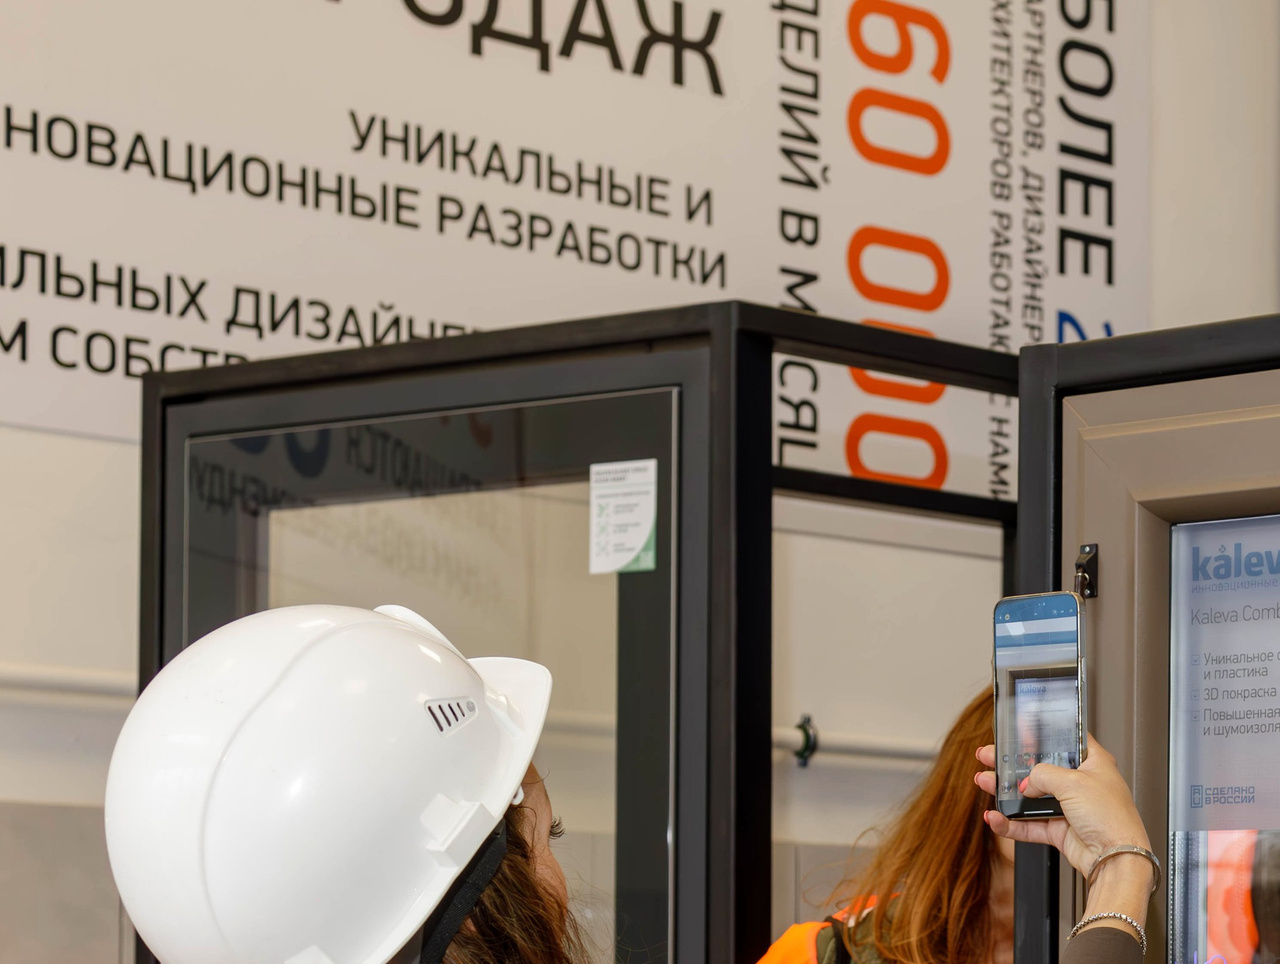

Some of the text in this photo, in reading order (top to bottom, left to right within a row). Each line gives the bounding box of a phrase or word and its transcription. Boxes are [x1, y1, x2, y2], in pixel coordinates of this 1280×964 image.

[347, 110, 713, 226] УНИКАЛЬНЫЕ И
[4, 105, 727, 289] НОВАЦИОННЫЕ РАЗРАБОТКИ
[779, 208, 820, 247] В
[1021, 166, 1048, 344] ДИЗАЙНЕР
[778, 266, 820, 467] МСЯЦ
[1190, 607, 1239, 626] Kaleva
[1203, 650, 1274, 666] Уникальное
[1203, 666, 1268, 680] и пластика
[1203, 686, 1277, 702] 3D покраска
[1203, 707, 1280, 721] Повышенная
[1203, 726, 1211, 736] и
[1205, 786, 1255, 796] СДЕЛАНО
[1213, 795, 1255, 805] РОССИИ
